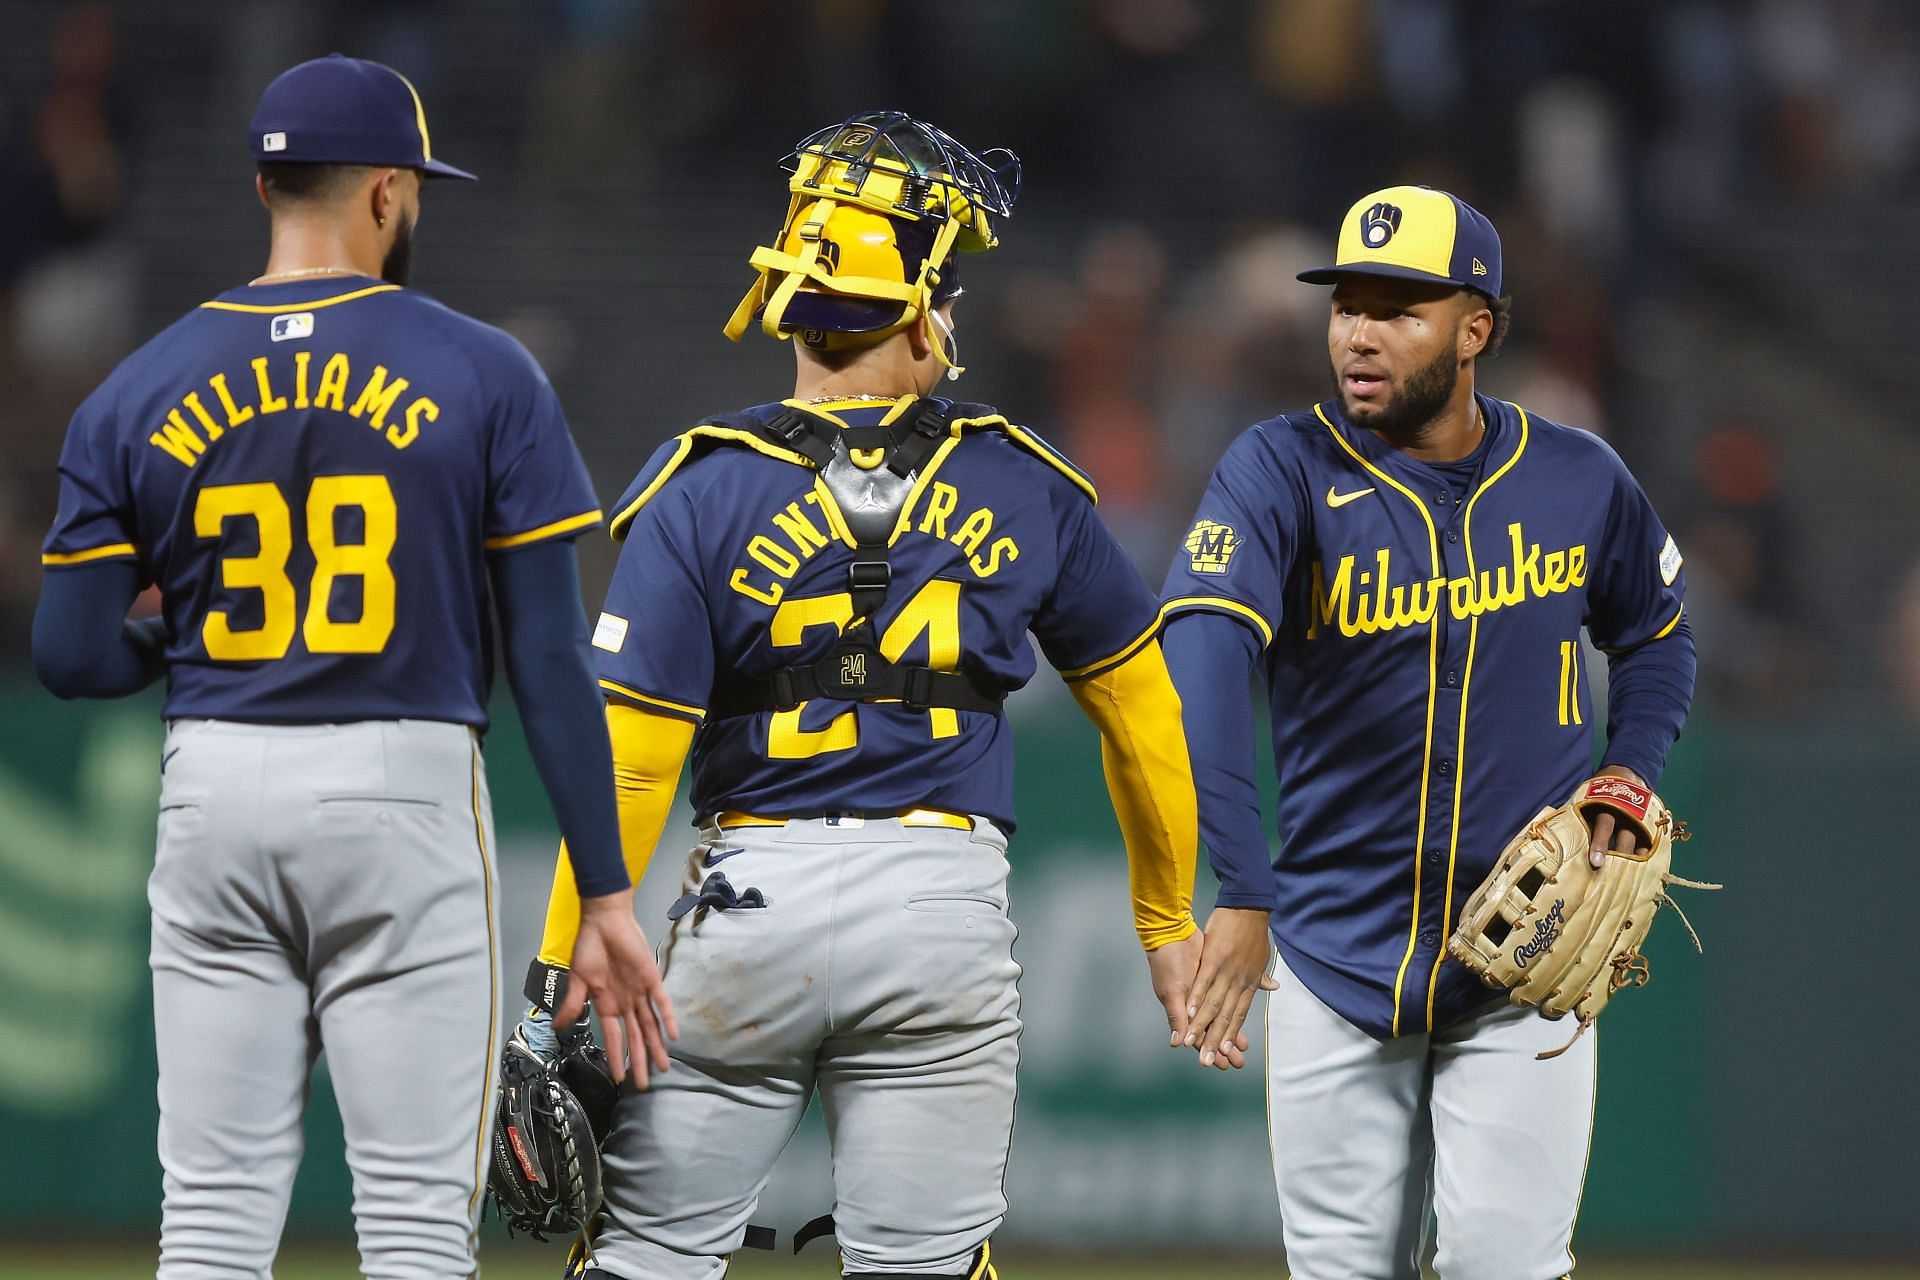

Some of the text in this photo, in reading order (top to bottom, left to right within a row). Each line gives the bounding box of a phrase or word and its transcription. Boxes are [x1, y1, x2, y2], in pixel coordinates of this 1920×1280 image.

[150, 352, 440, 468] WILLIAMS
[193, 474, 397, 660] 38
[1306, 522, 1589, 640] Milwaukee
[768, 579, 962, 759] 24
[841, 653, 867, 685] 24
[1558, 641, 1582, 726] 11
[1592, 783, 1645, 805] Rawlings
[1513, 898, 1565, 968] Rawlings
[543, 969, 560, 1008] ALL-STAR
